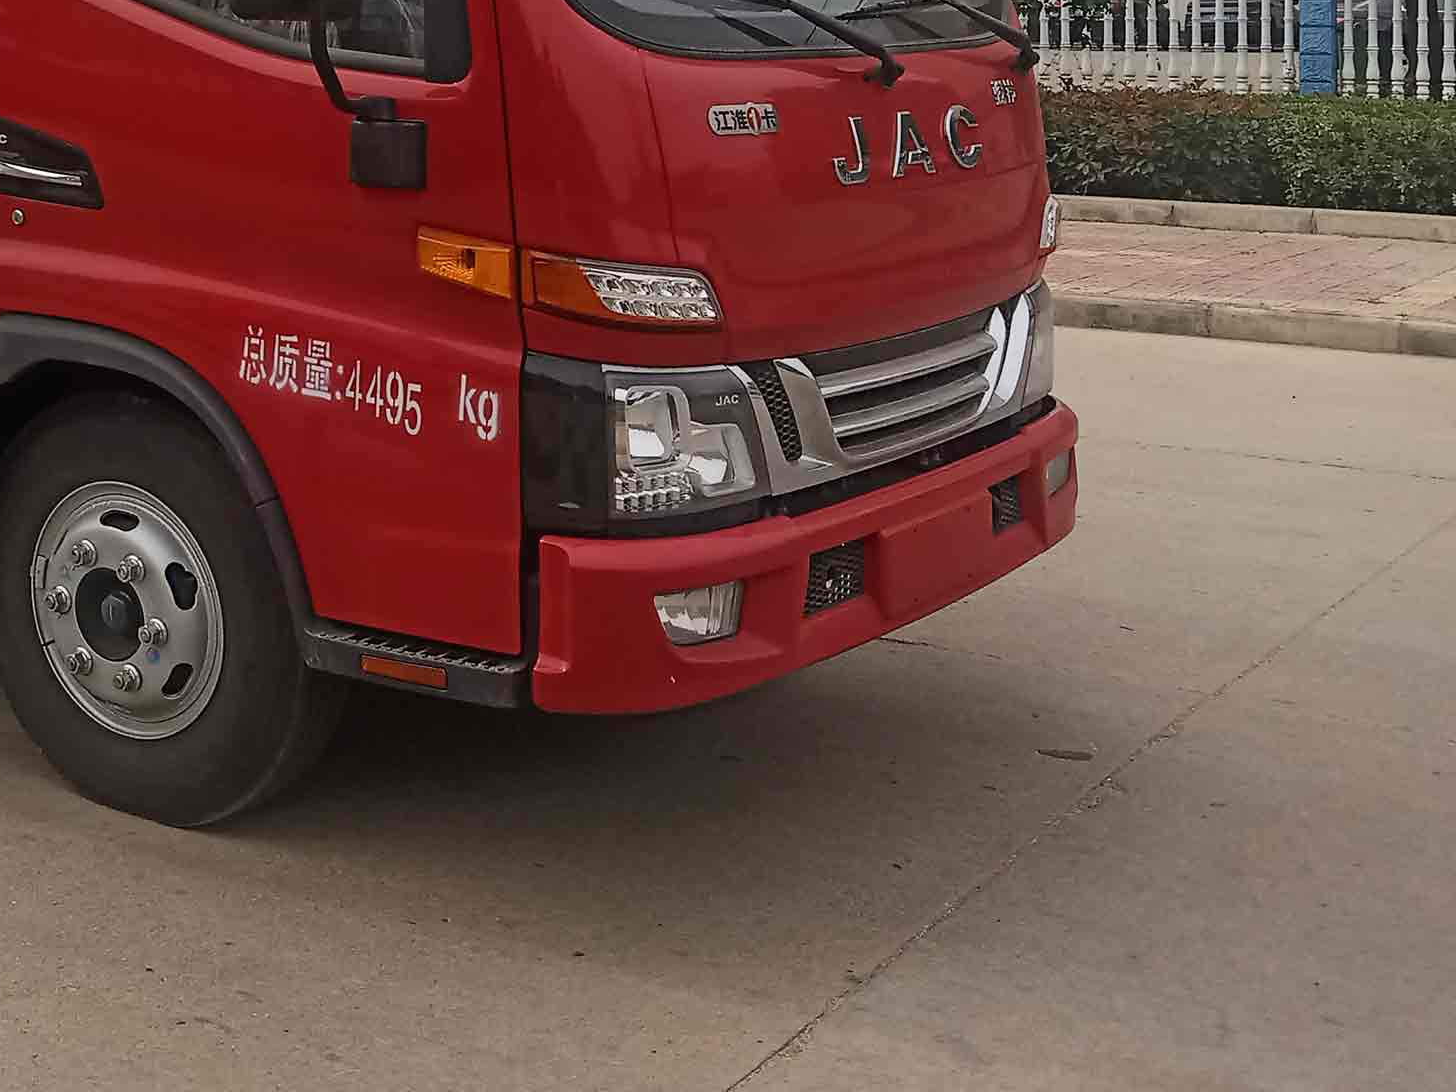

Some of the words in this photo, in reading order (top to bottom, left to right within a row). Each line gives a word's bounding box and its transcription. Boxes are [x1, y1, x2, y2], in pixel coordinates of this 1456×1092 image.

[833, 105, 982, 185] JAC
[458, 374, 499, 441] kg
[715, 394, 740, 406] JAC
